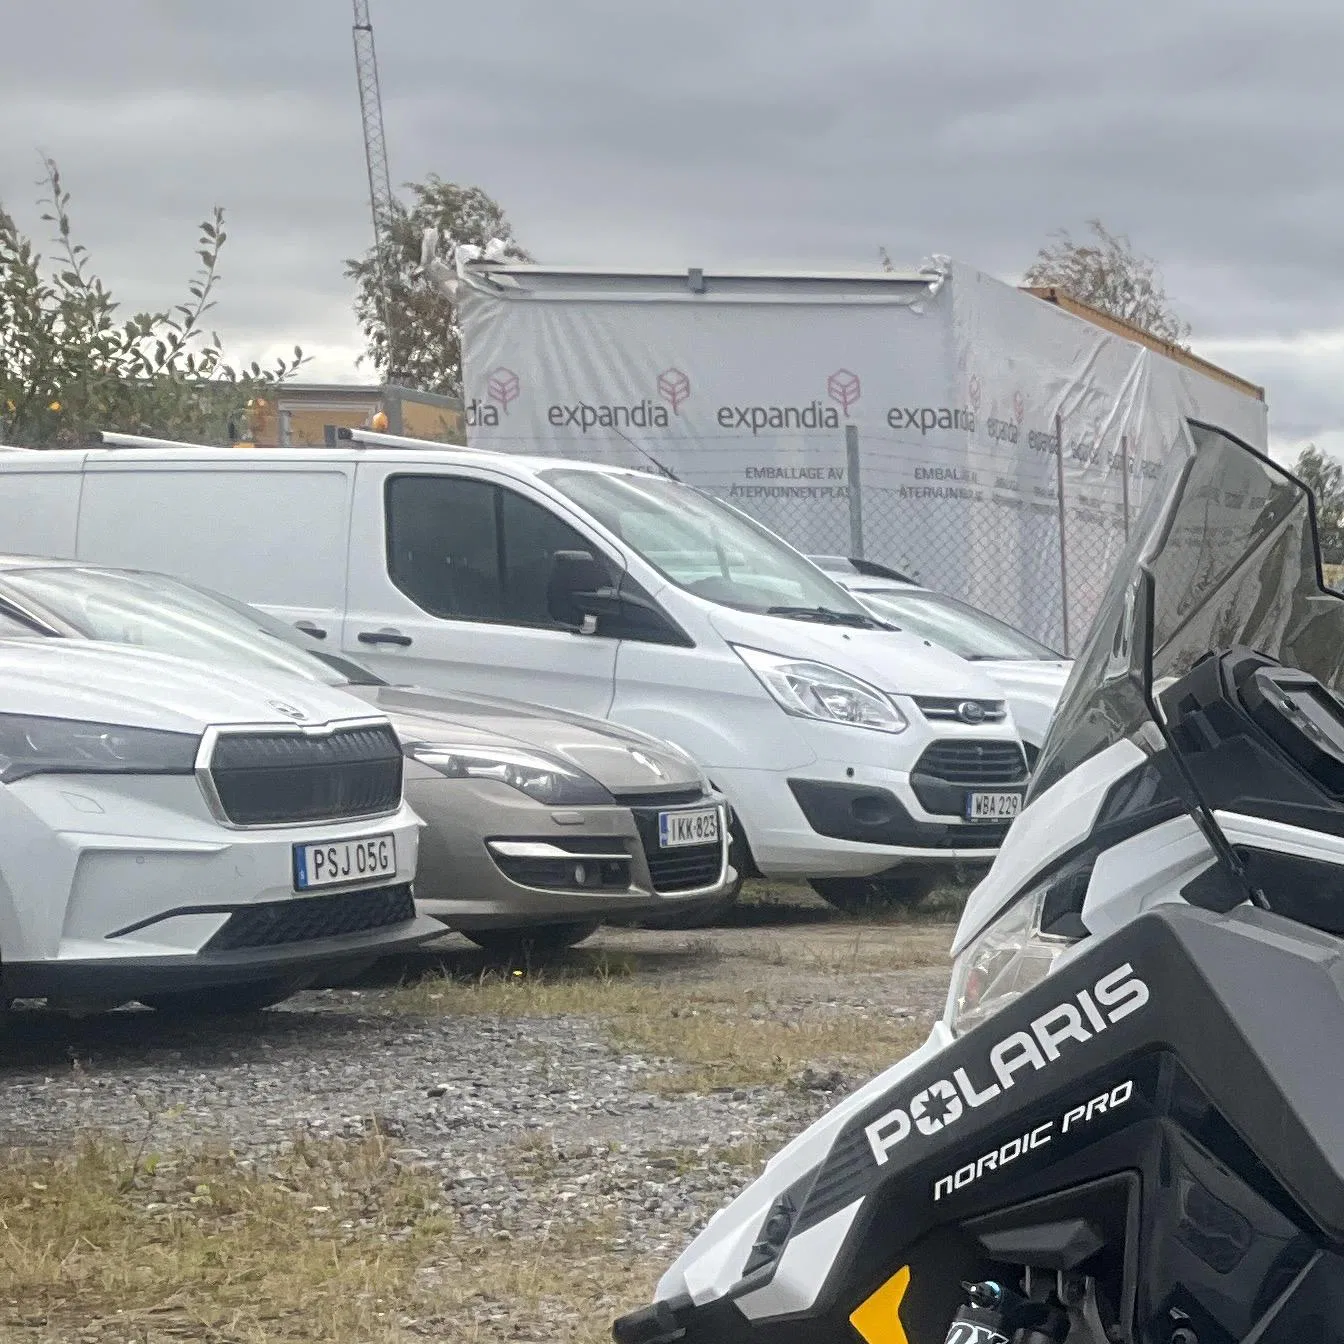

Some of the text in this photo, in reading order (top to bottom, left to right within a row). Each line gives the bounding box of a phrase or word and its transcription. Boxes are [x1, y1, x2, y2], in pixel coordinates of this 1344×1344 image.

[548, 399, 669, 433] expandia
[717, 401, 839, 437] expandia
[745, 466, 844, 480] EMBALLAGE AV
[313, 845, 351, 880] PSJ
[356, 840, 389, 873] 05G
[864, 962, 1150, 1166] POLARIS
[934, 1080, 1133, 1201] NORDIC PRO
